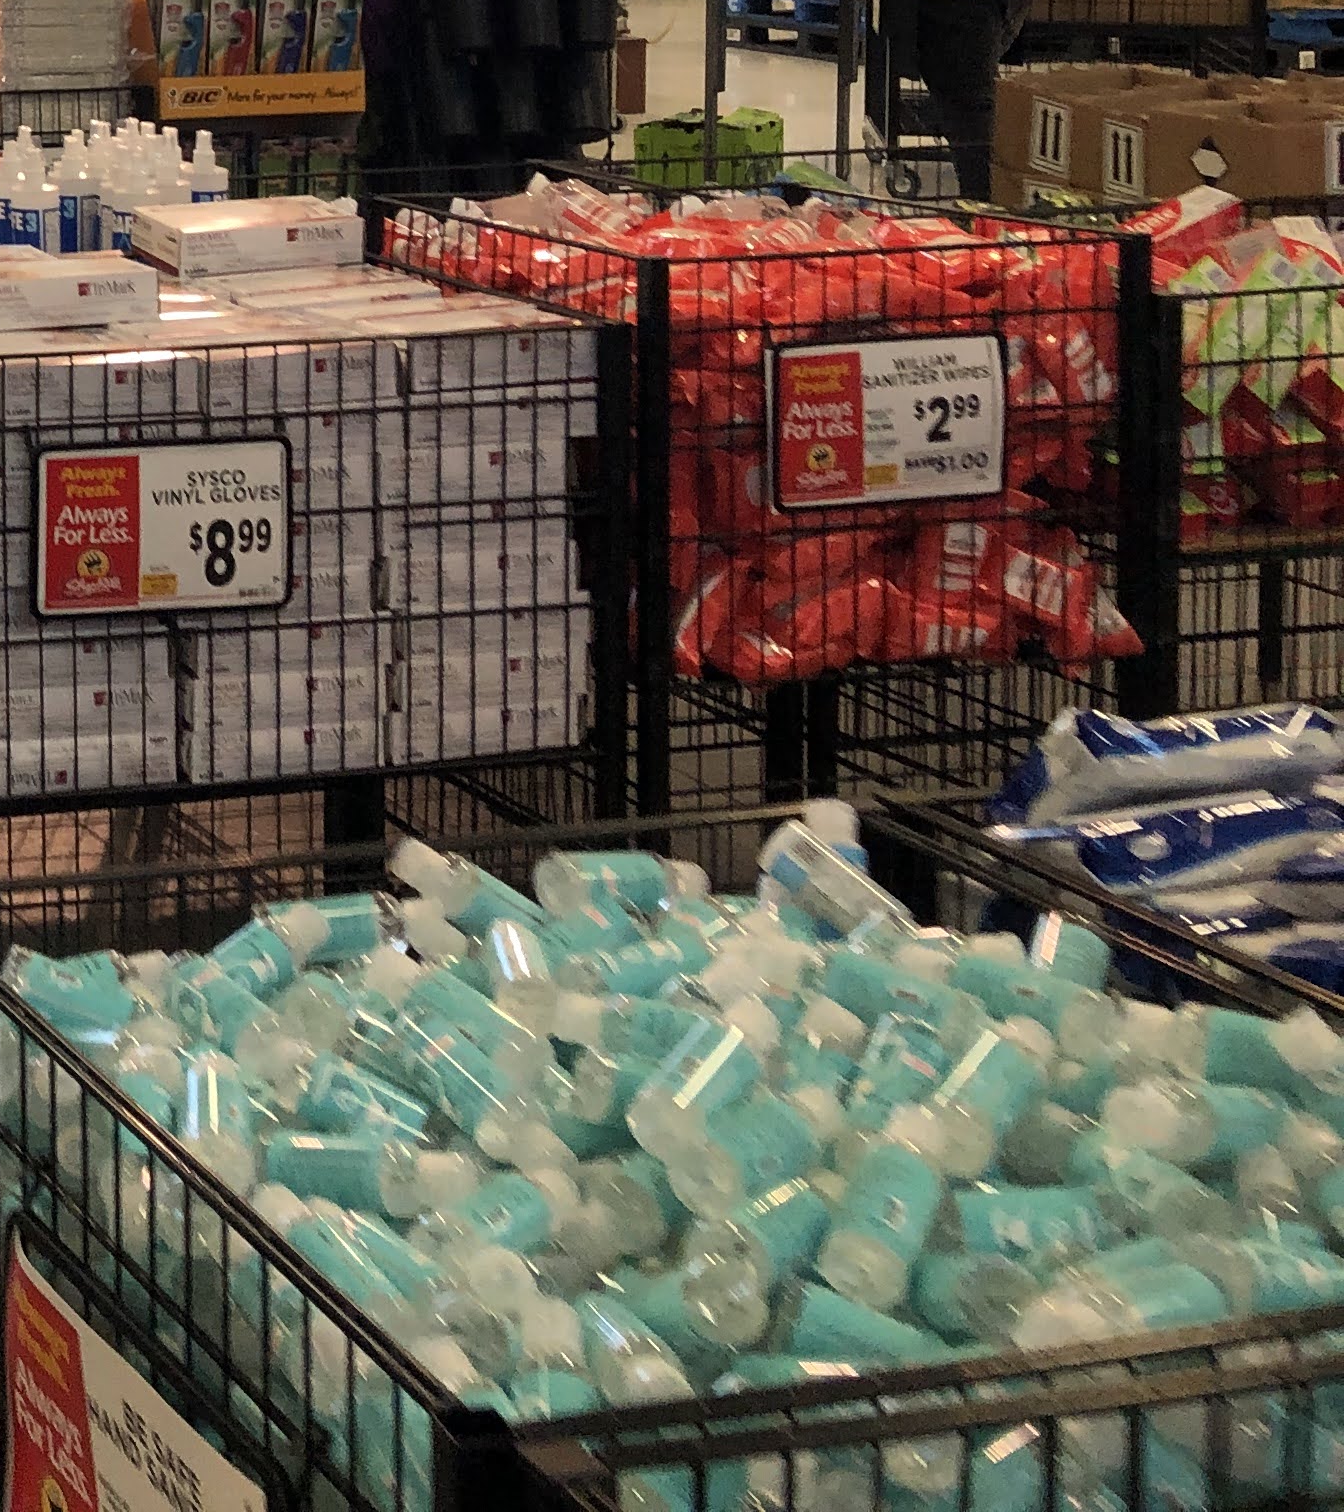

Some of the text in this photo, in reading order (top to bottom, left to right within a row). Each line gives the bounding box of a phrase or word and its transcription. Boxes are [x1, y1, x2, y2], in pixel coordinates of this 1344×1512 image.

[181, 91, 219, 104] BIC
[267, 93, 288, 105] your
[787, 401, 855, 422] Always
[782, 421, 811, 441] For
[186, 469, 246, 487] SYSCO
[152, 484, 281, 506] VINYL GLOVES
[57, 504, 129, 526] Always
[53, 523, 135, 546] For Less.
[15, 1355, 83, 1459] Always
